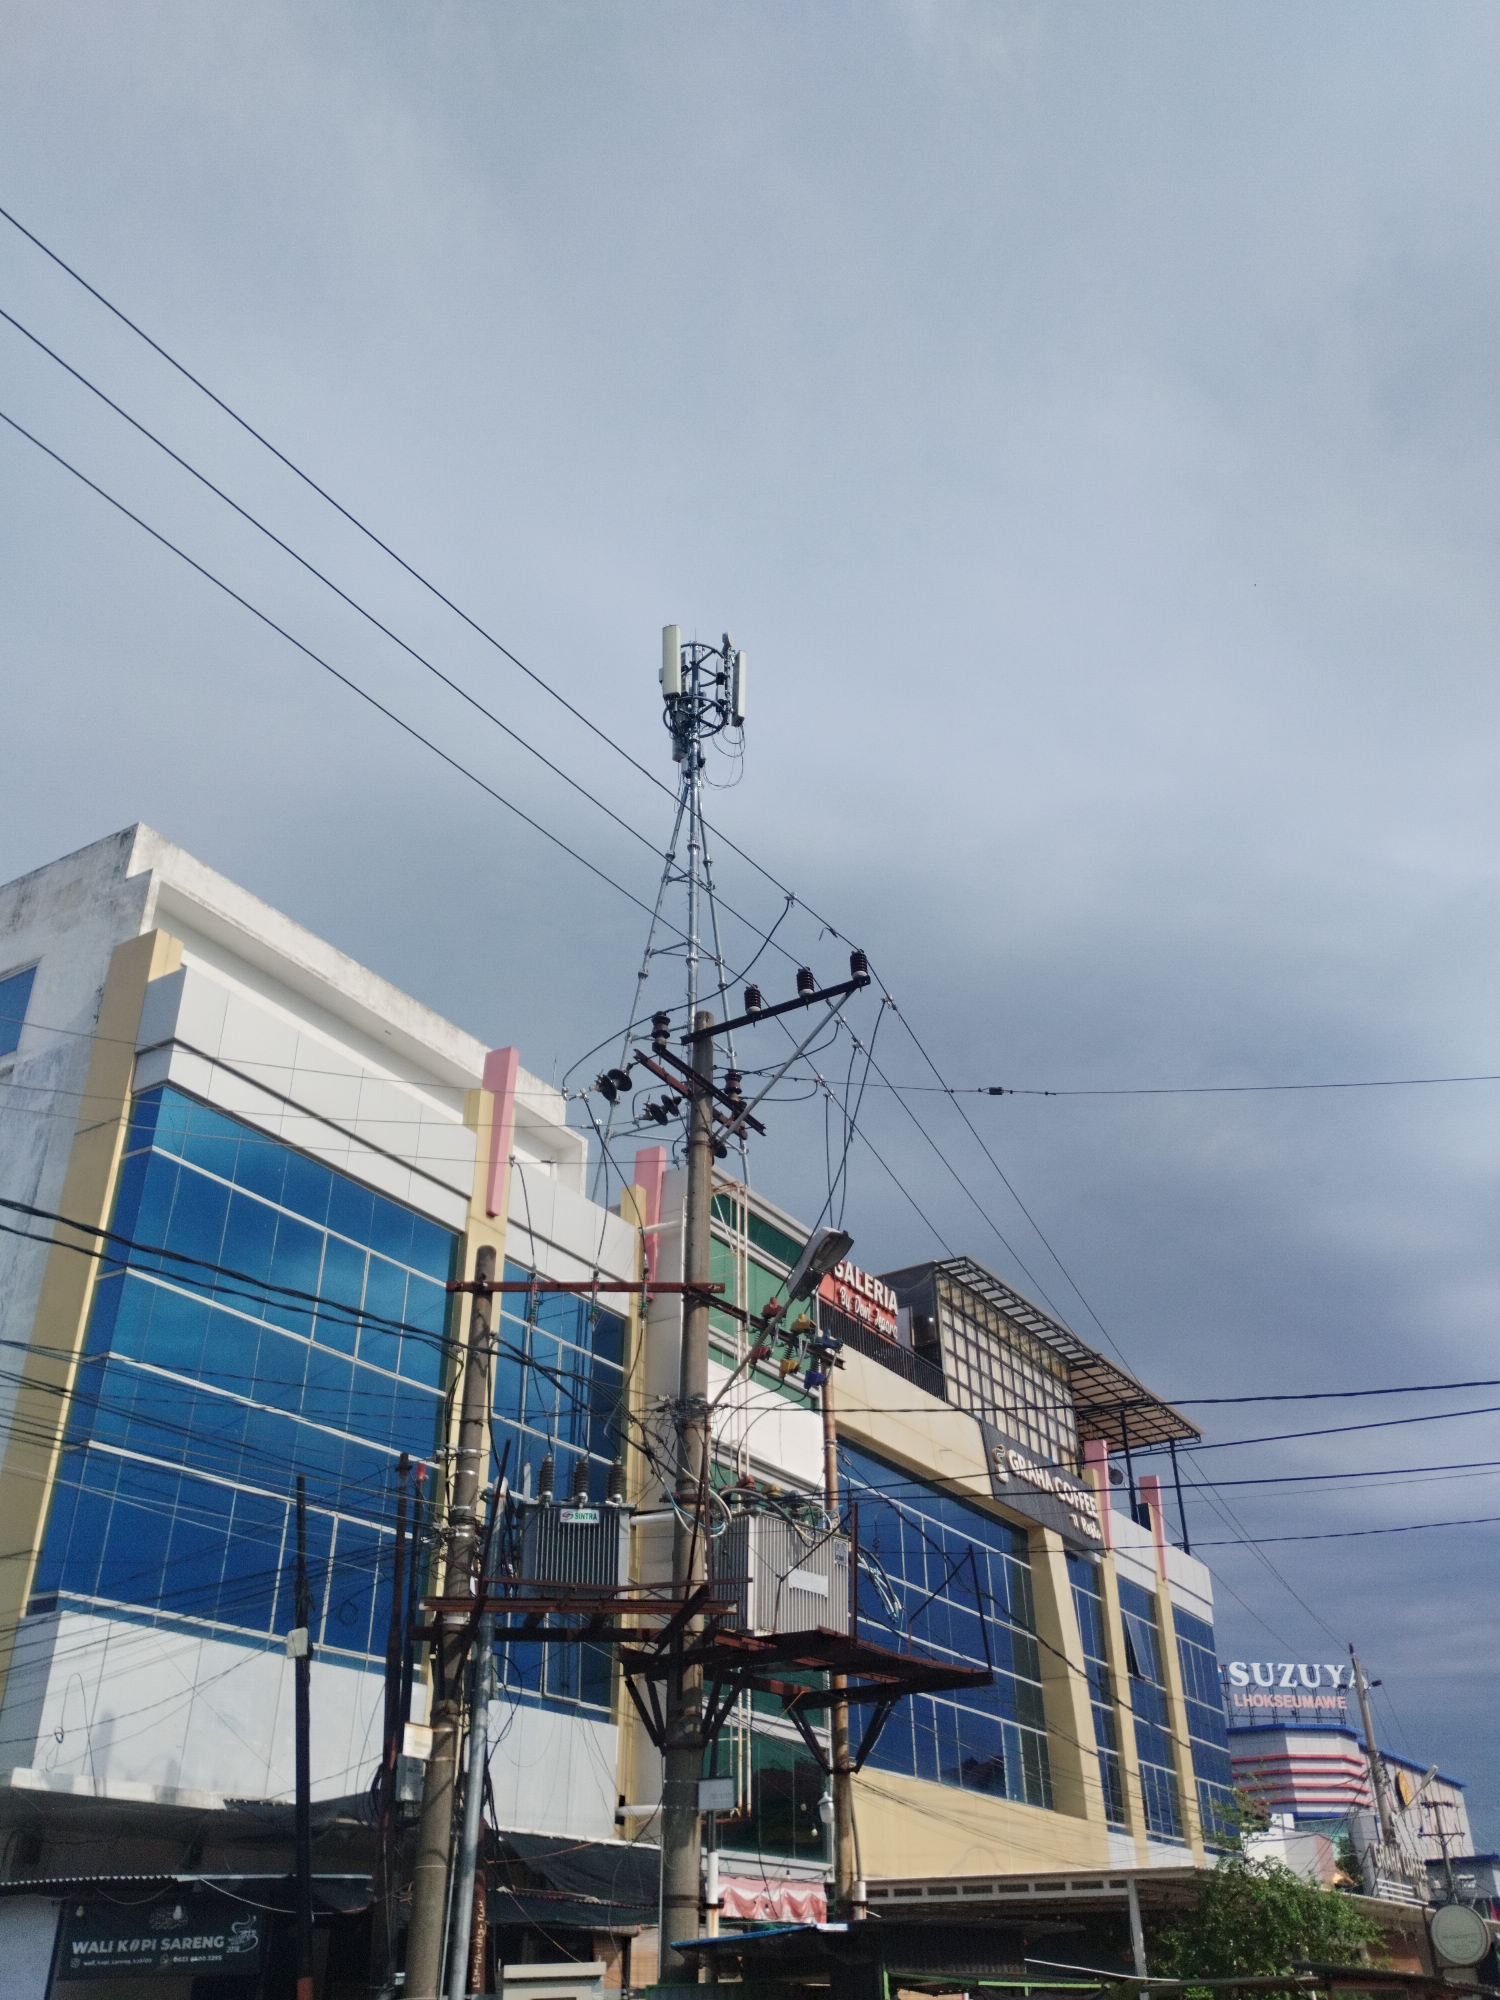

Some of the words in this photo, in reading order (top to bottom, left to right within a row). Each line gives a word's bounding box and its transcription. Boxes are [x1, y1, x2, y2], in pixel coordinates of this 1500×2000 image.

[834, 1260, 898, 1316] GALERIA
[1006, 1449, 1055, 1494] GRAHA
[1052, 1476, 1099, 1519] COFFEE
[574, 1512, 598, 1520] SINTRA
[1233, 1693, 1348, 1710] LHOKSEUMAWE
[72, 1940, 114, 1955] WALI
[160, 1935, 225, 1951] SARENG
